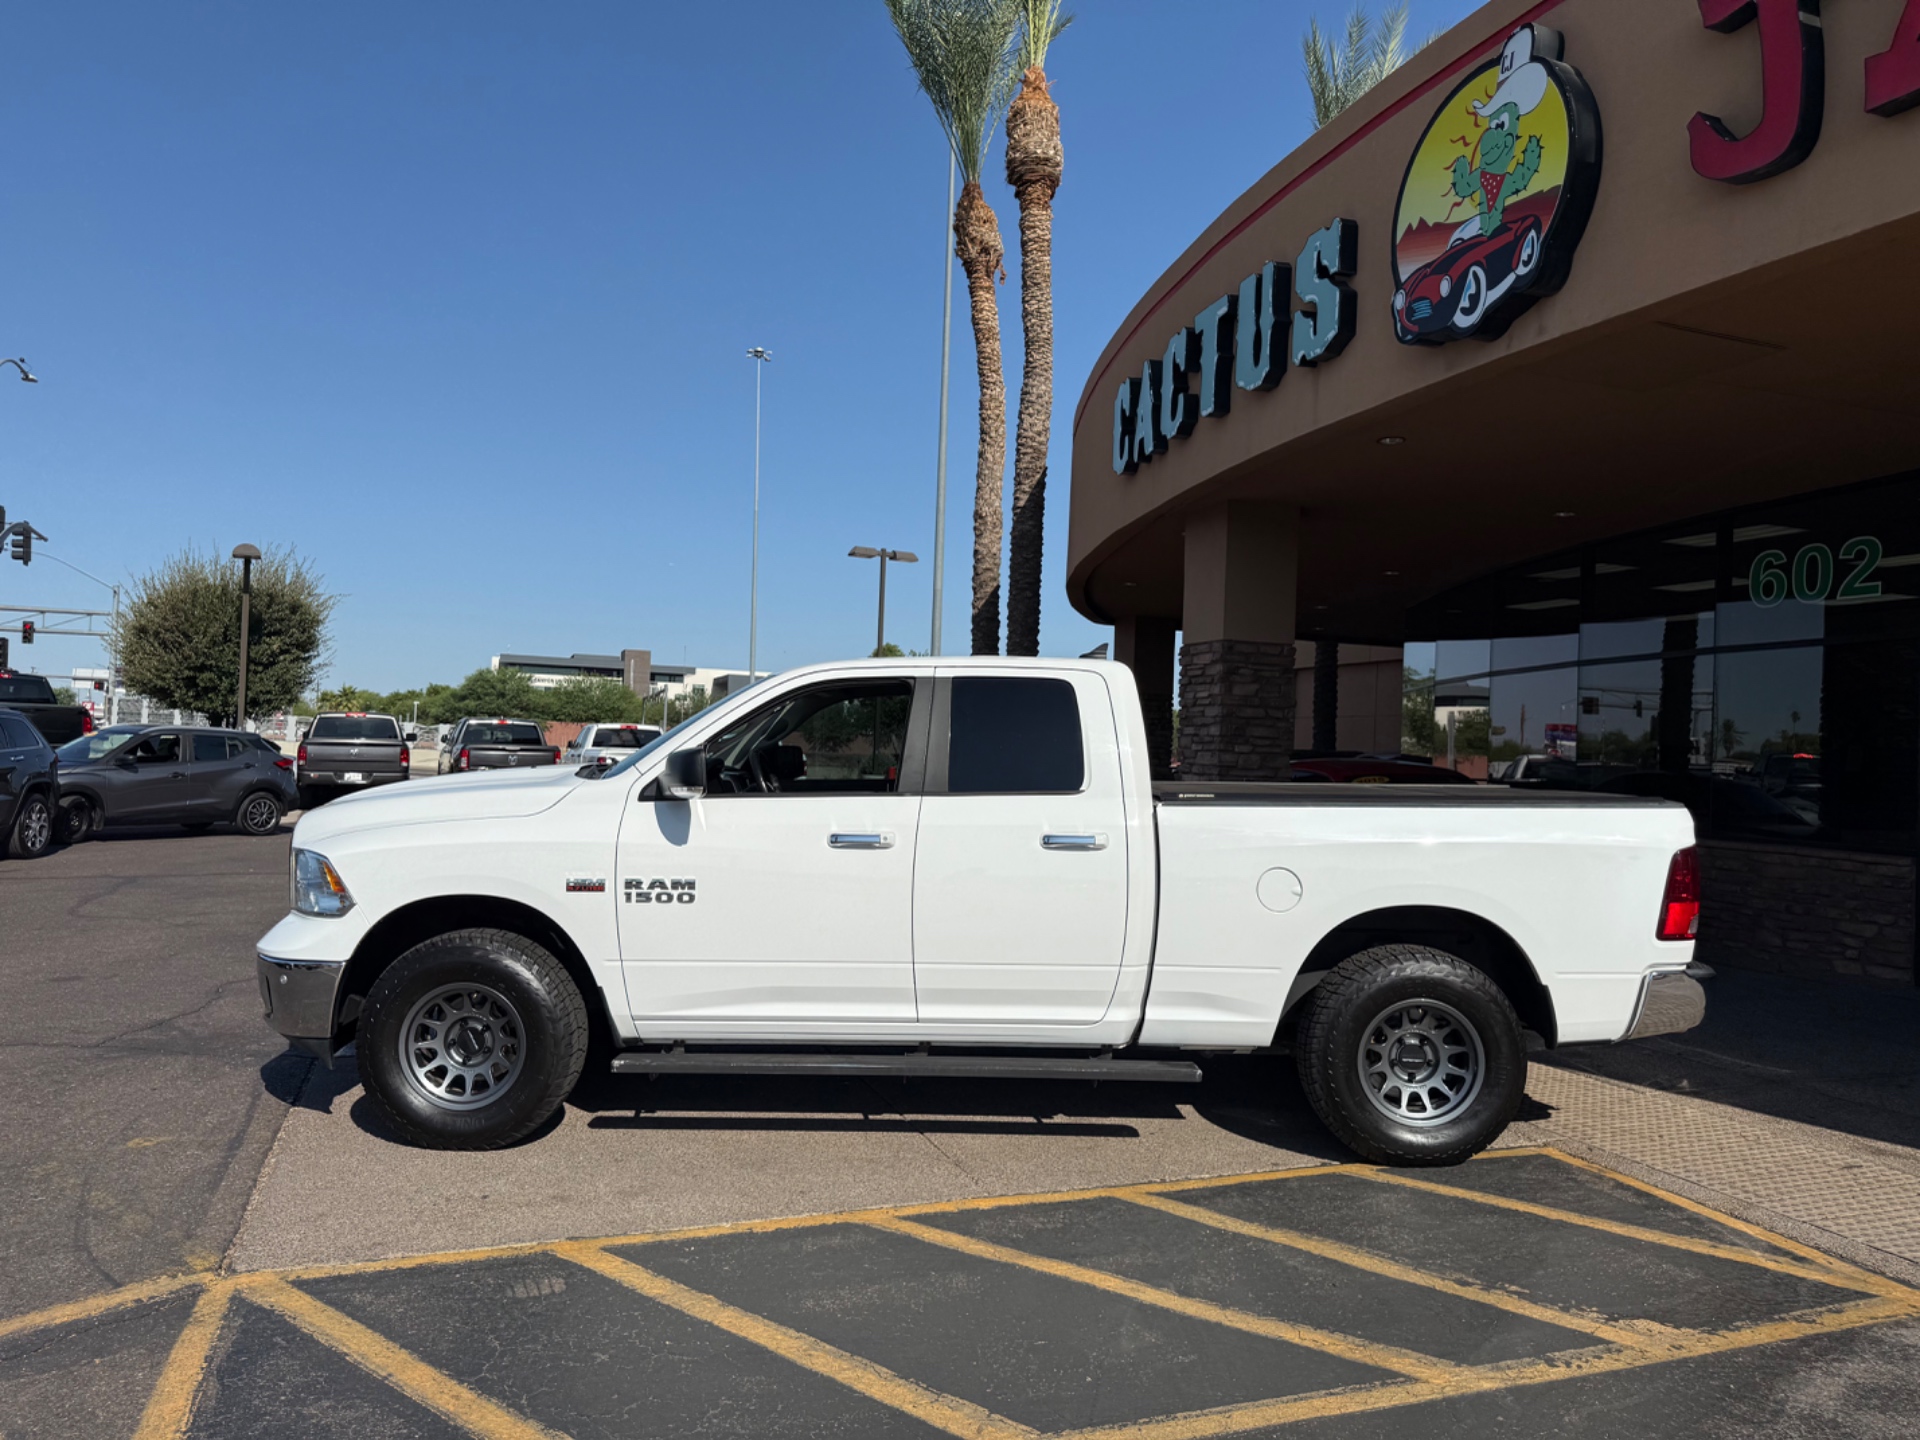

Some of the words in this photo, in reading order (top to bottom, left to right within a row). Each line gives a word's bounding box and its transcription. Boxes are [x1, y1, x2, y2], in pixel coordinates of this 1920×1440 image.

[1501, 51, 1515, 74] CJ
[1112, 217, 1358, 475] CACTUS
[1749, 536, 1883, 608] 602
[624, 878, 696, 891] RAM
[624, 892, 696, 904] 1500
